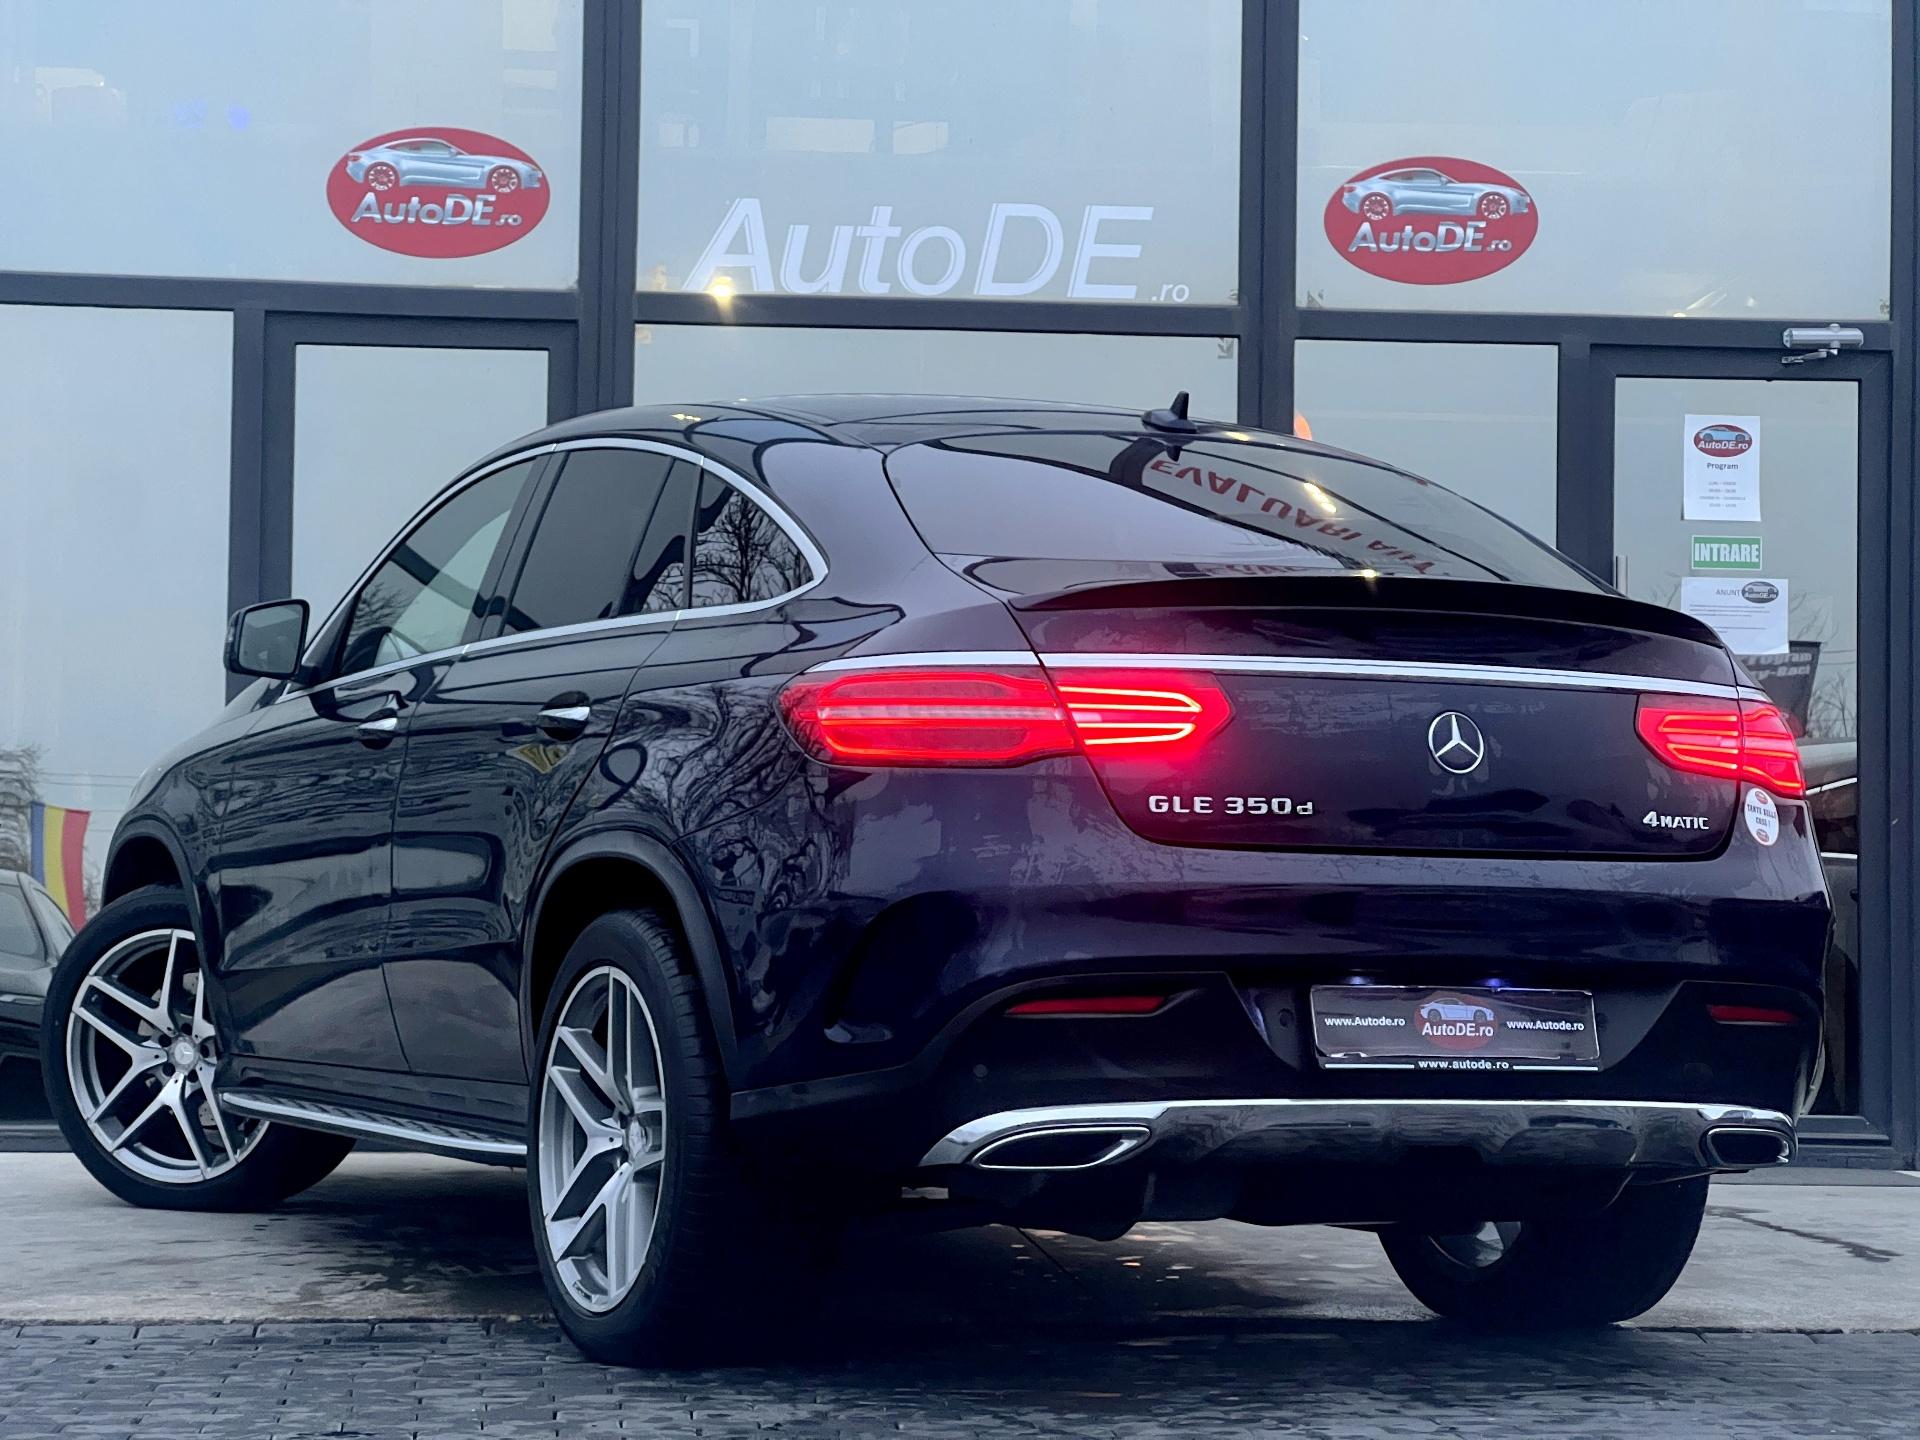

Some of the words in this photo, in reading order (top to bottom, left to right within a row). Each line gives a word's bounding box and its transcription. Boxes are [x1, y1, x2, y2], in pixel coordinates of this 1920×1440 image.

[1698, 440, 1748, 449] AutoDE.ro
[1706, 462, 1739, 470] Program
[1694, 543, 1759, 562] INTRARE
[1149, 795, 1213, 813] GLE
[1224, 796, 1313, 815] 350d
[1643, 811, 1710, 830] 4MATIC
[1325, 1016, 1405, 1027] www.Autode.ro
[1507, 1020, 1584, 1031] www.Autode.ro
[1422, 1022, 1494, 1037] AutoDE.ro
[1418, 1060, 1509, 1070] www.autode.ro
